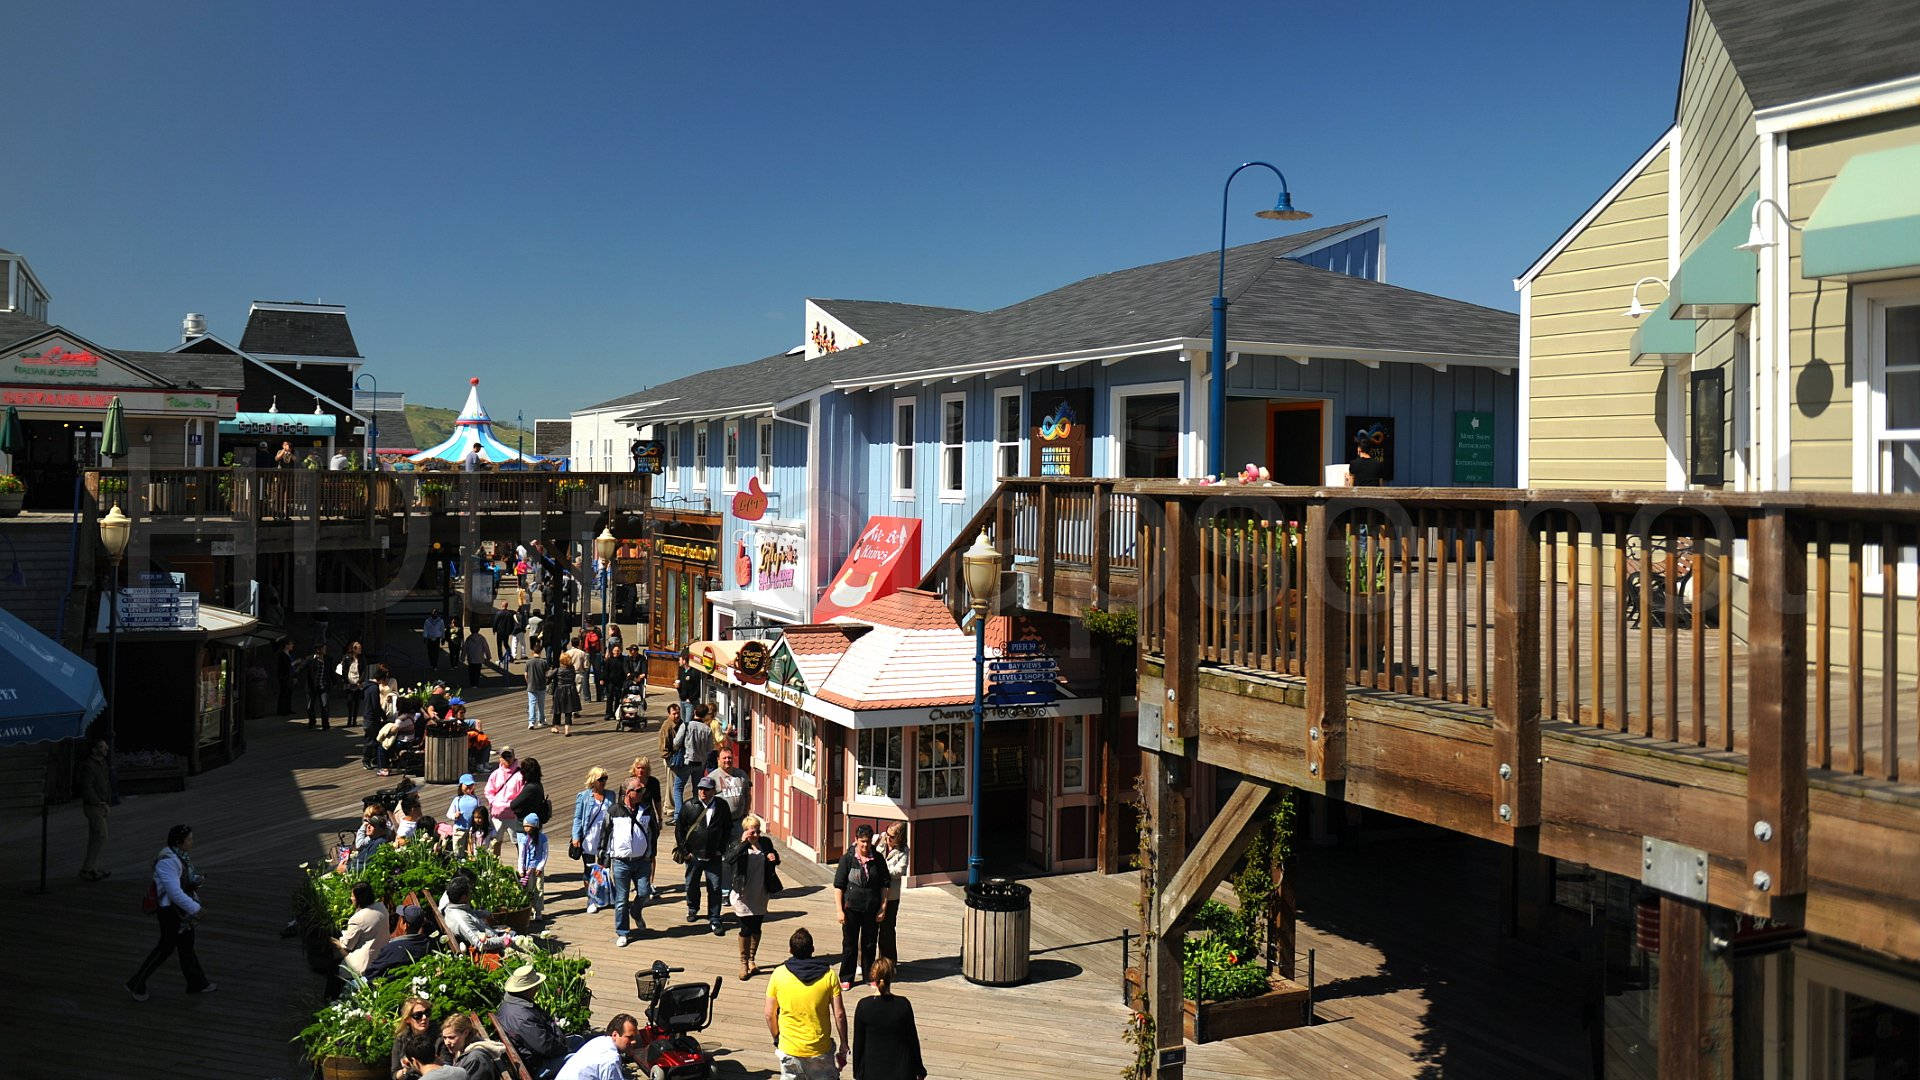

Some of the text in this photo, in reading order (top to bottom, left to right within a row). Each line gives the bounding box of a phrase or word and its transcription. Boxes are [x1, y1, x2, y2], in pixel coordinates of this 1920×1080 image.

[57, 369, 98, 377] SEAFOOD
[1041, 464, 1071, 475] MIRROR
[860, 544, 889, 560] Knives
[1011, 643, 1027, 651] PIER
[929, 707, 974, 721] Charms
